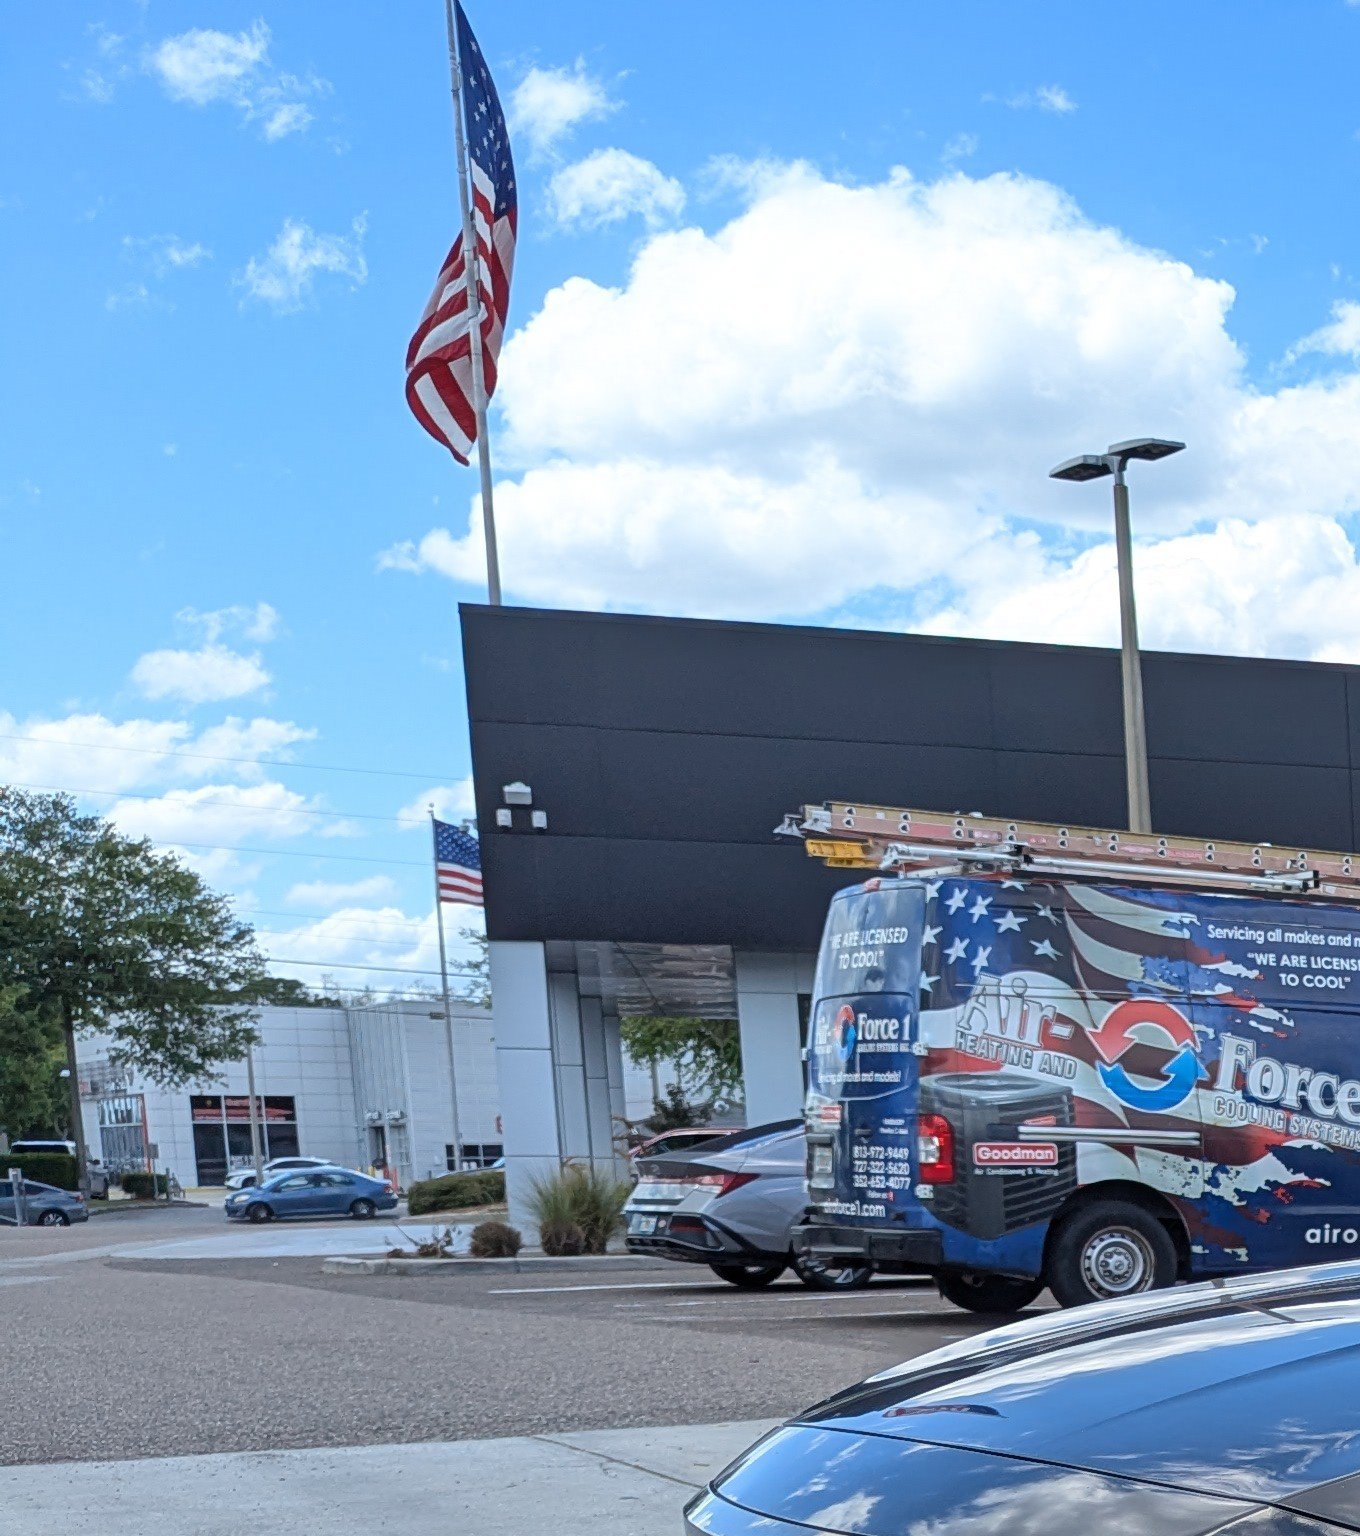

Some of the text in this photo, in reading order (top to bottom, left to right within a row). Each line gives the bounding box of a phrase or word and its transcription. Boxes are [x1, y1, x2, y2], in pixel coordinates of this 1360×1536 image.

[860, 927, 909, 946] LICENSED
[1207, 925, 1264, 944] Servicing
[1267, 928, 1282, 942] all
[1284, 931, 1325, 946] makes
[1328, 933, 1351, 947] and
[1280, 954, 1307, 968] ARE
[1279, 973, 1299, 987] TO
[857, 1012, 900, 1041] Force
[903, 1013, 911, 1041] 1
[955, 1030, 1078, 1080] HEATING AND
[1214, 1096, 1287, 1134] COOLING
[977, 1146, 1054, 1160] Goodman
